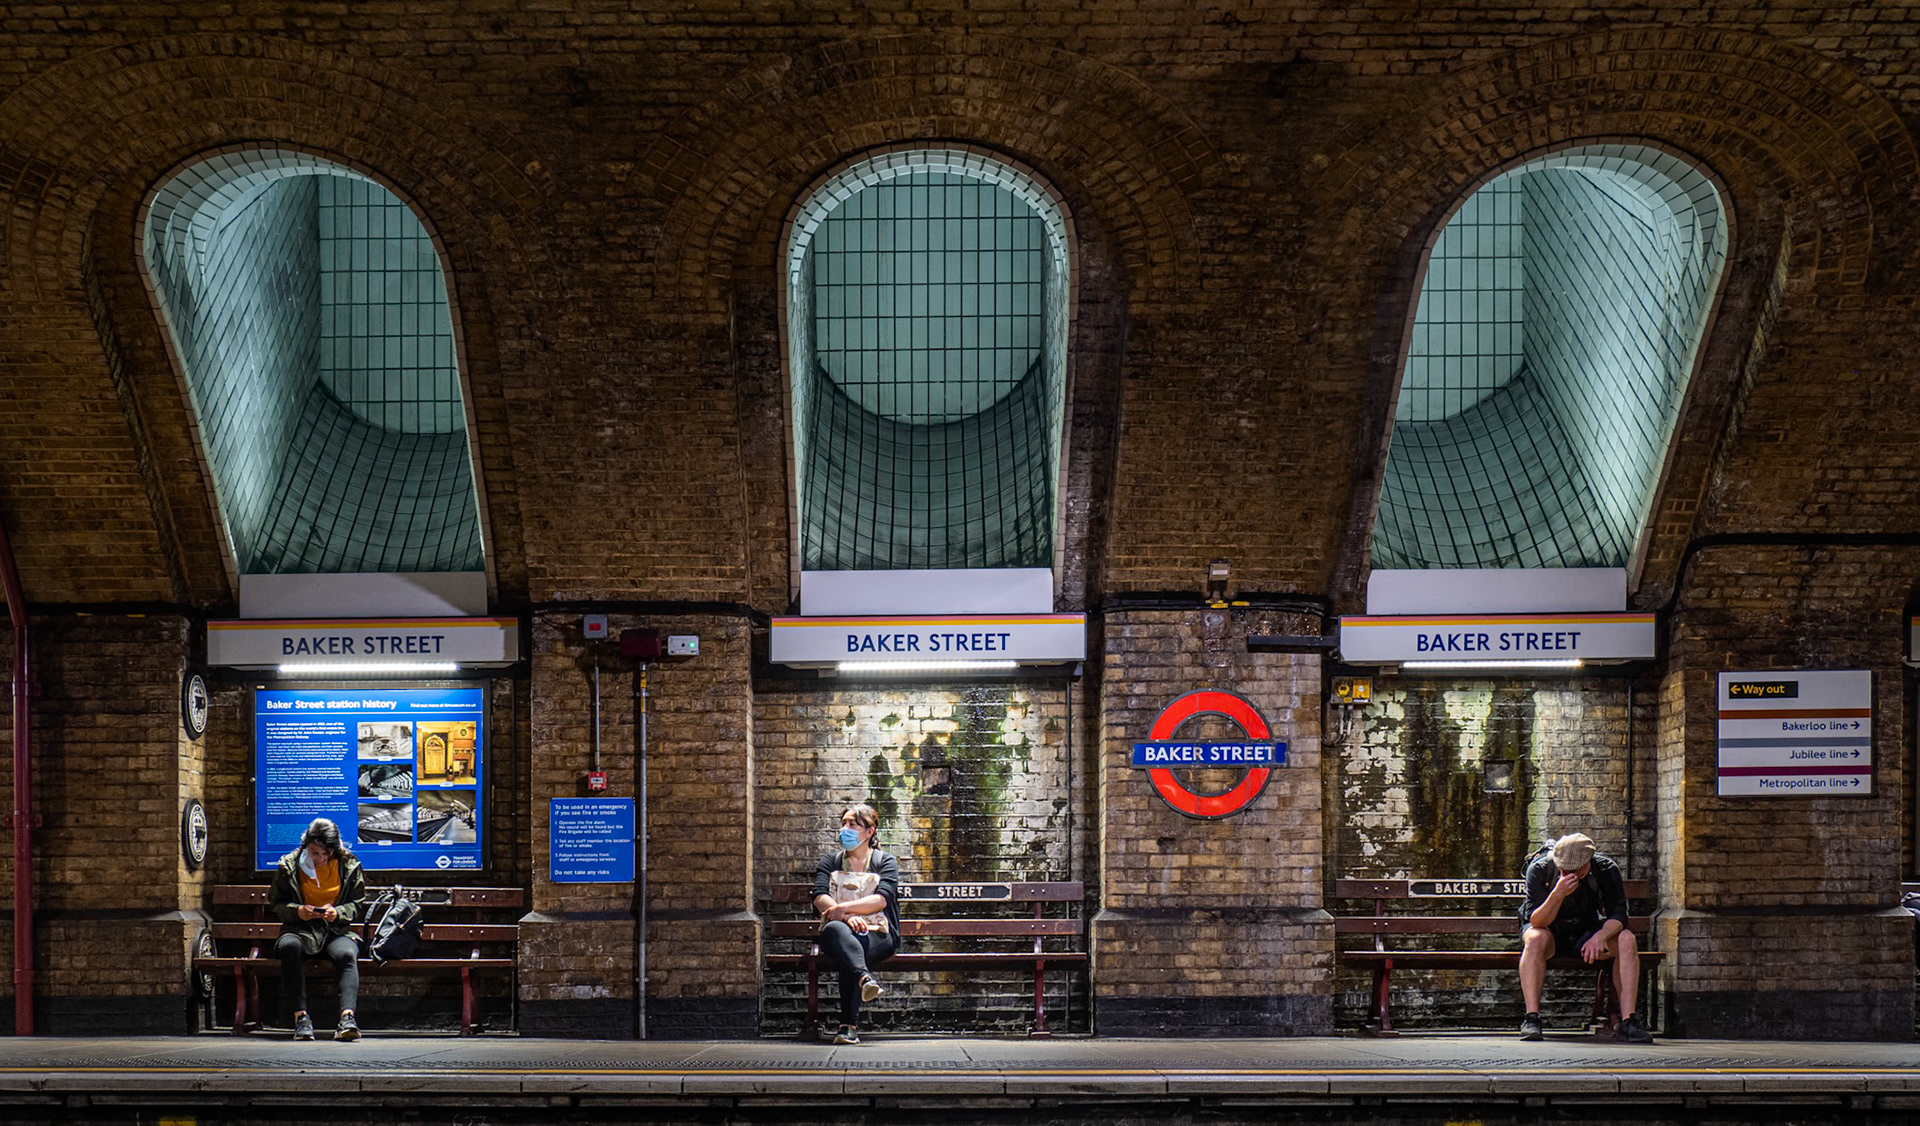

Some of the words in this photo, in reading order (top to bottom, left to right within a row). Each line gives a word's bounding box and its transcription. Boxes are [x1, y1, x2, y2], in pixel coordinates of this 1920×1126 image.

[282, 637, 356, 655] BAKER
[363, 636, 445, 654] STREET
[847, 634, 921, 652] BAKER
[929, 633, 1011, 652] STREET
[1417, 634, 1491, 652] BAKER
[1499, 632, 1582, 650] STREET
[1742, 685, 1764, 696] Way
[1766, 685, 1785, 694] out
[266, 700, 293, 709] Baker
[295, 700, 325, 709] Street
[326, 700, 360, 708] station
[362, 700, 397, 710] history
[1782, 721, 1826, 731] Bakerloo
[1830, 720, 1848, 730] line
[1145, 747, 1204, 761] BAKER
[1210, 746, 1275, 761] STREET
[1789, 750, 1826, 759] Jubilee
[1830, 749, 1848, 759] line
[1759, 778, 1826, 789] Metropolitan
[1830, 778, 1848, 787] line
[938, 886, 982, 897] STREET
[1435, 883, 1478, 894] BAKER
[1504, 883, 1526, 893] STR
